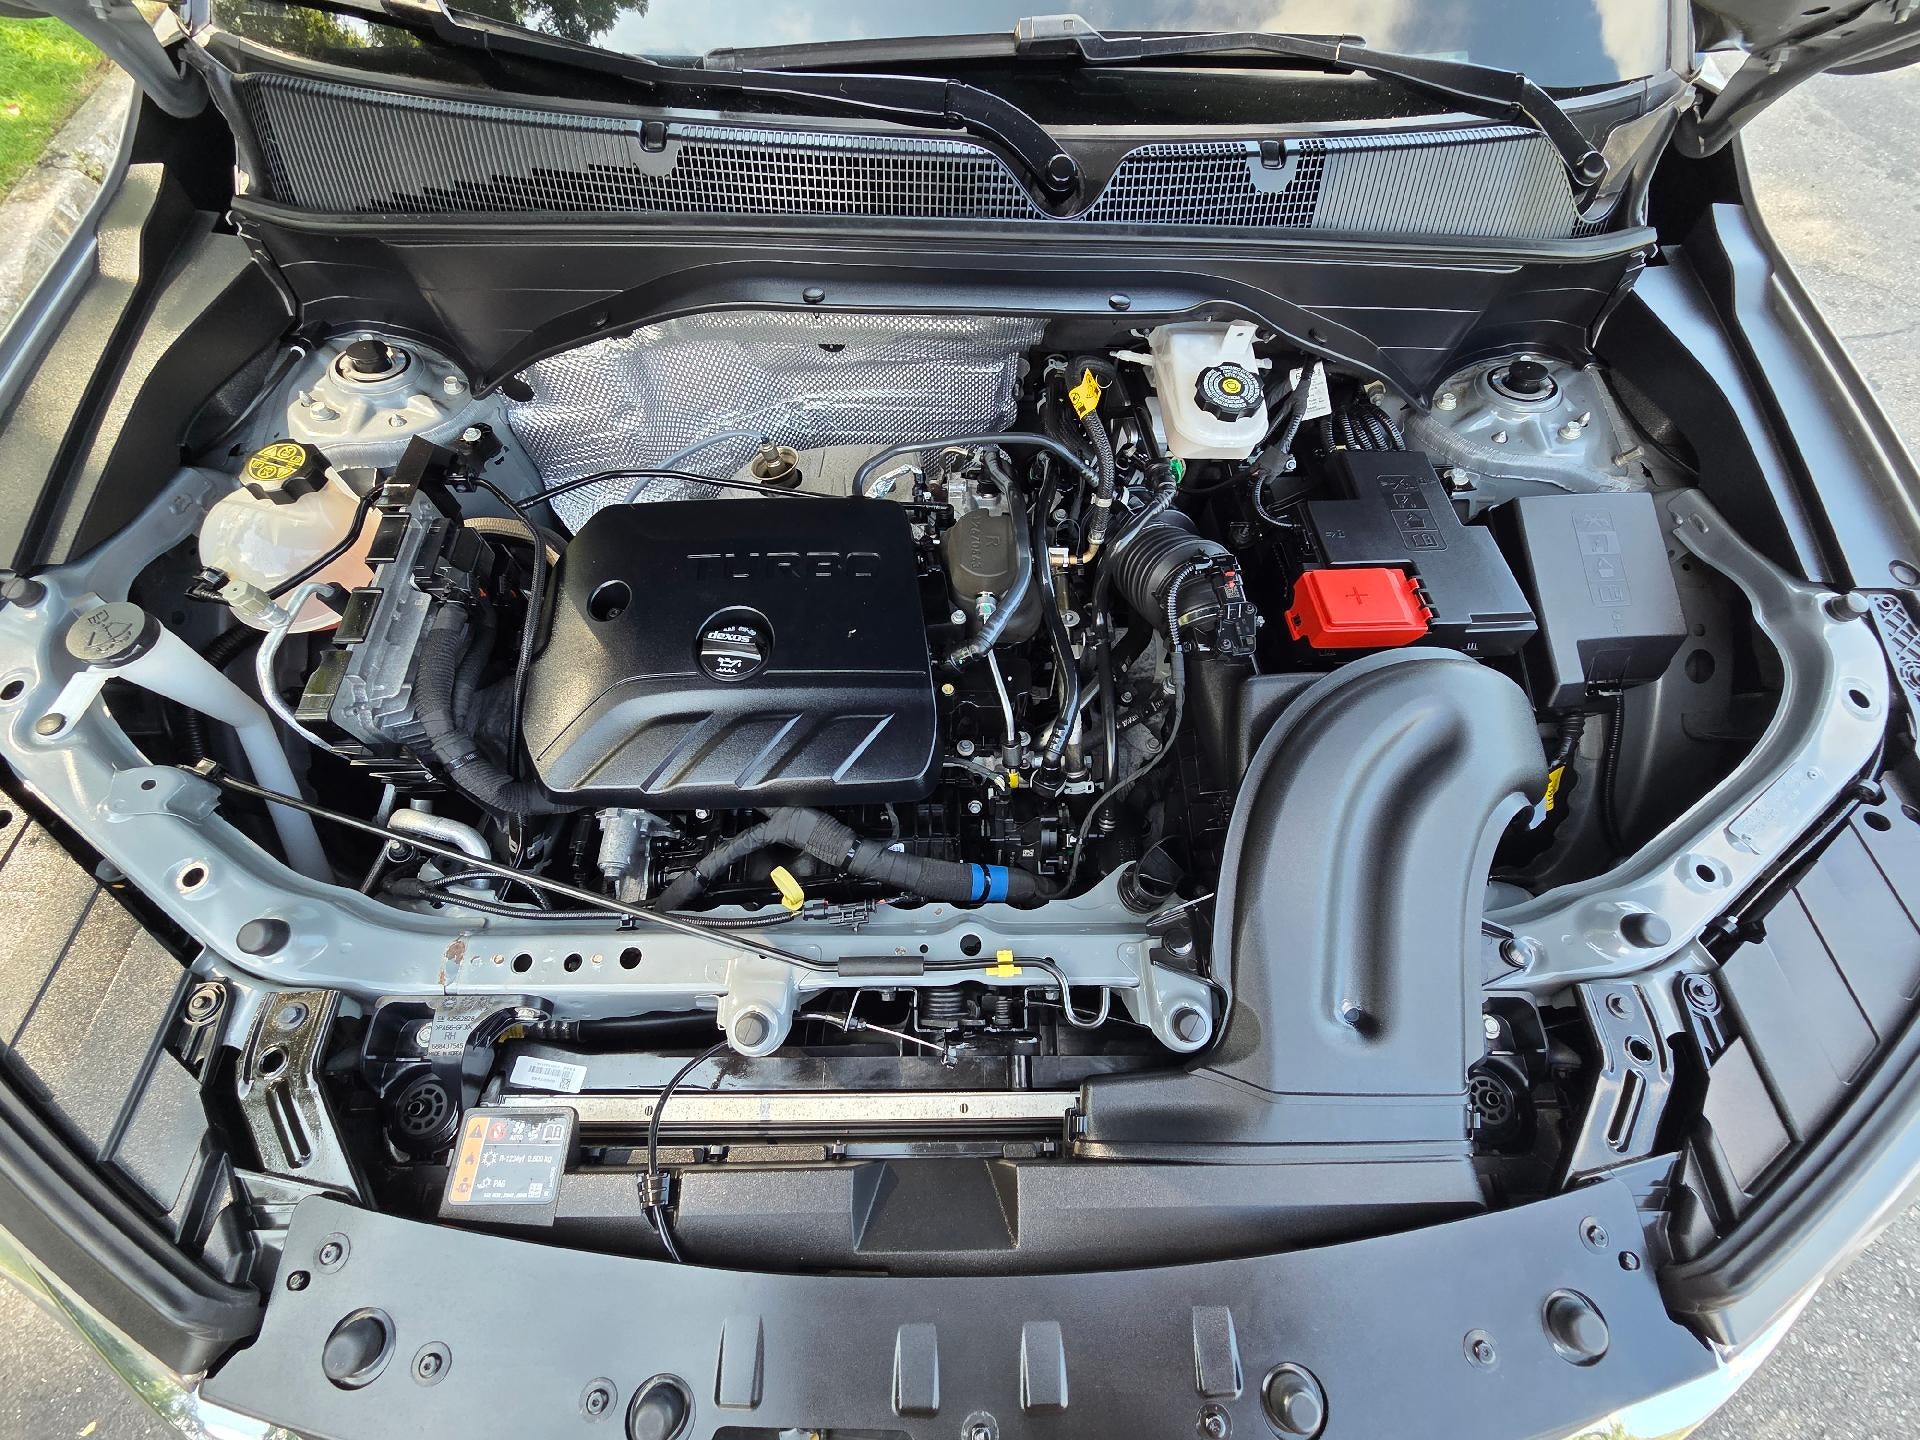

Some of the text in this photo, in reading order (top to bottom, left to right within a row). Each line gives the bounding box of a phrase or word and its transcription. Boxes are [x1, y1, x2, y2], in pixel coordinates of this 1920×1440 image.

[985, 535, 1000, 546] R
[686, 552, 881, 579] TURBO
[707, 630, 752, 642] dexos
[444, 1031, 457, 1041] RH
